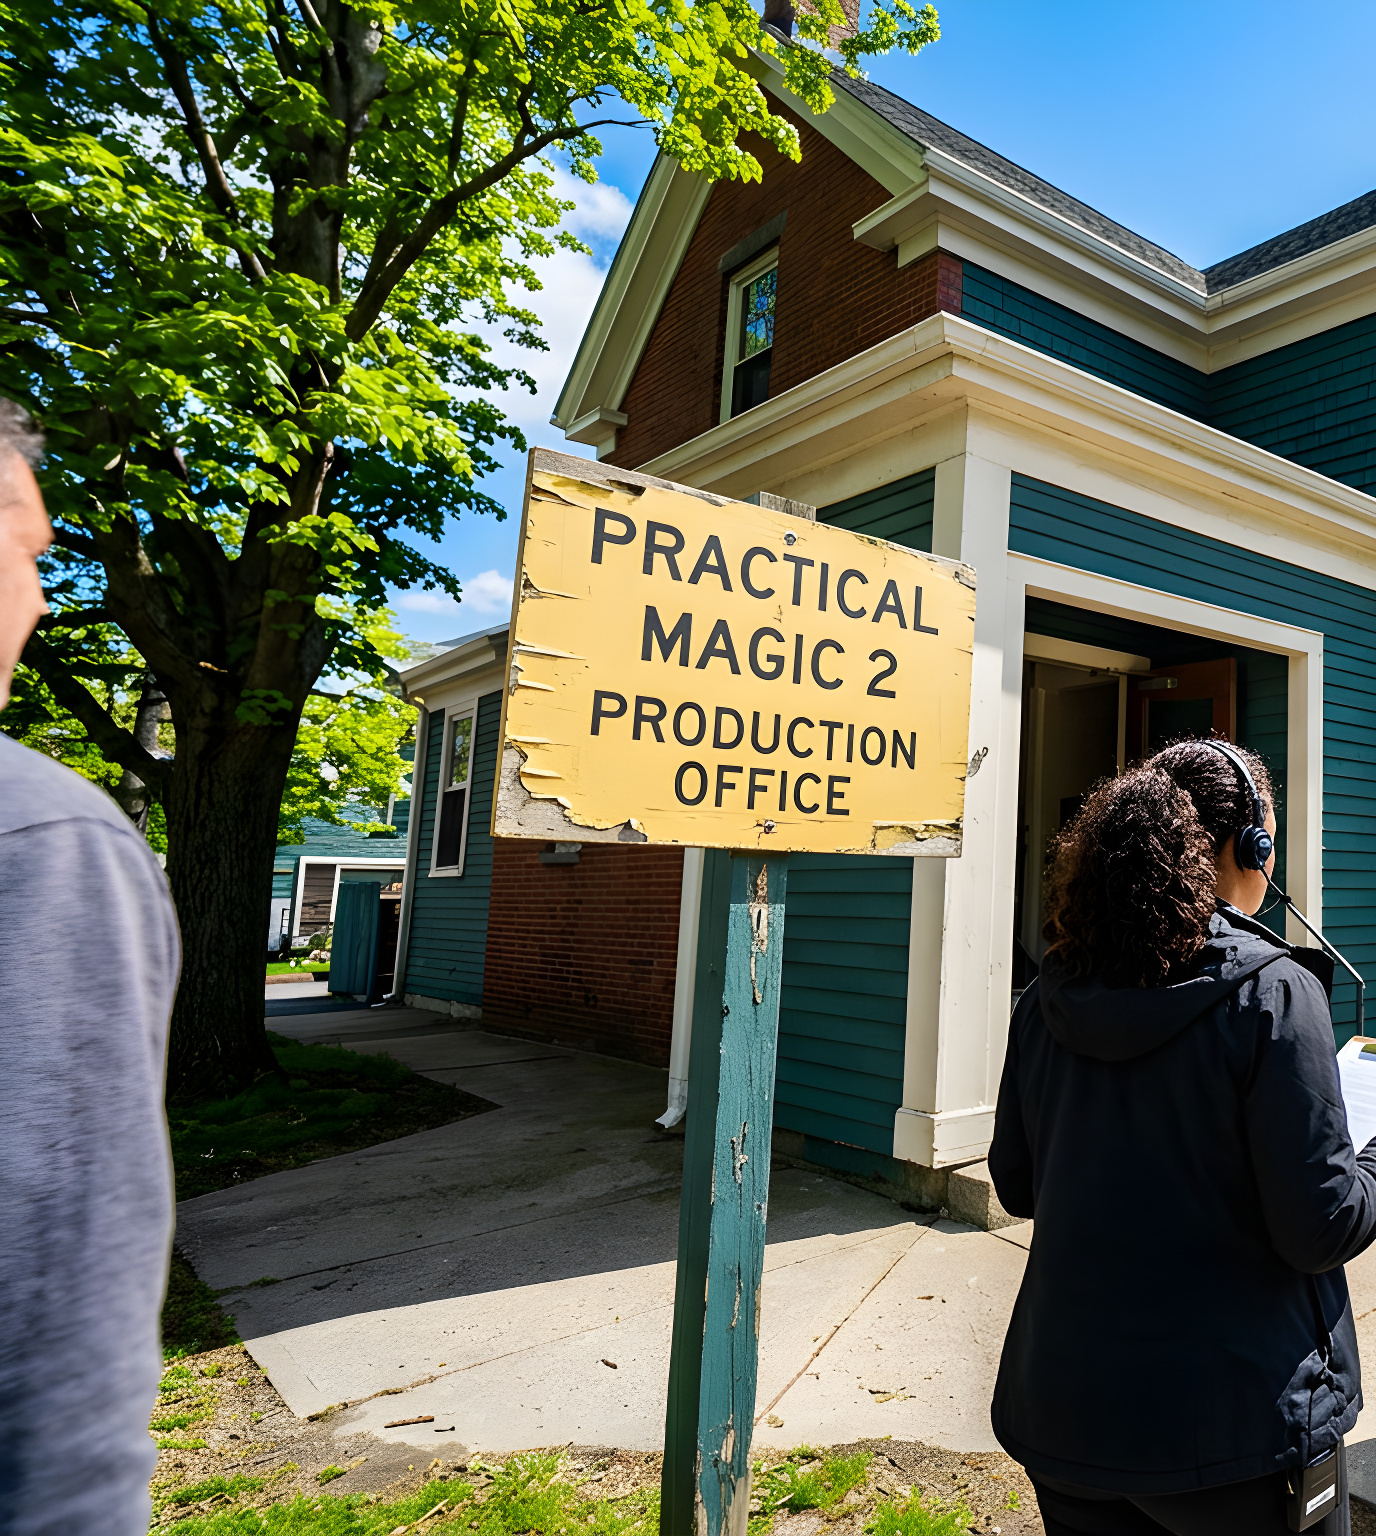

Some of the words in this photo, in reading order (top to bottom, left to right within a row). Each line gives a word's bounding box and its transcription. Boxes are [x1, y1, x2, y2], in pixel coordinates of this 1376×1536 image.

[590, 506, 939, 636] PRACTICAL
[640, 604, 845, 690] MAGIC
[866, 648, 898, 699] 2
[590, 689, 917, 770] PRODUCTION
[674, 760, 851, 816] OFFICE
